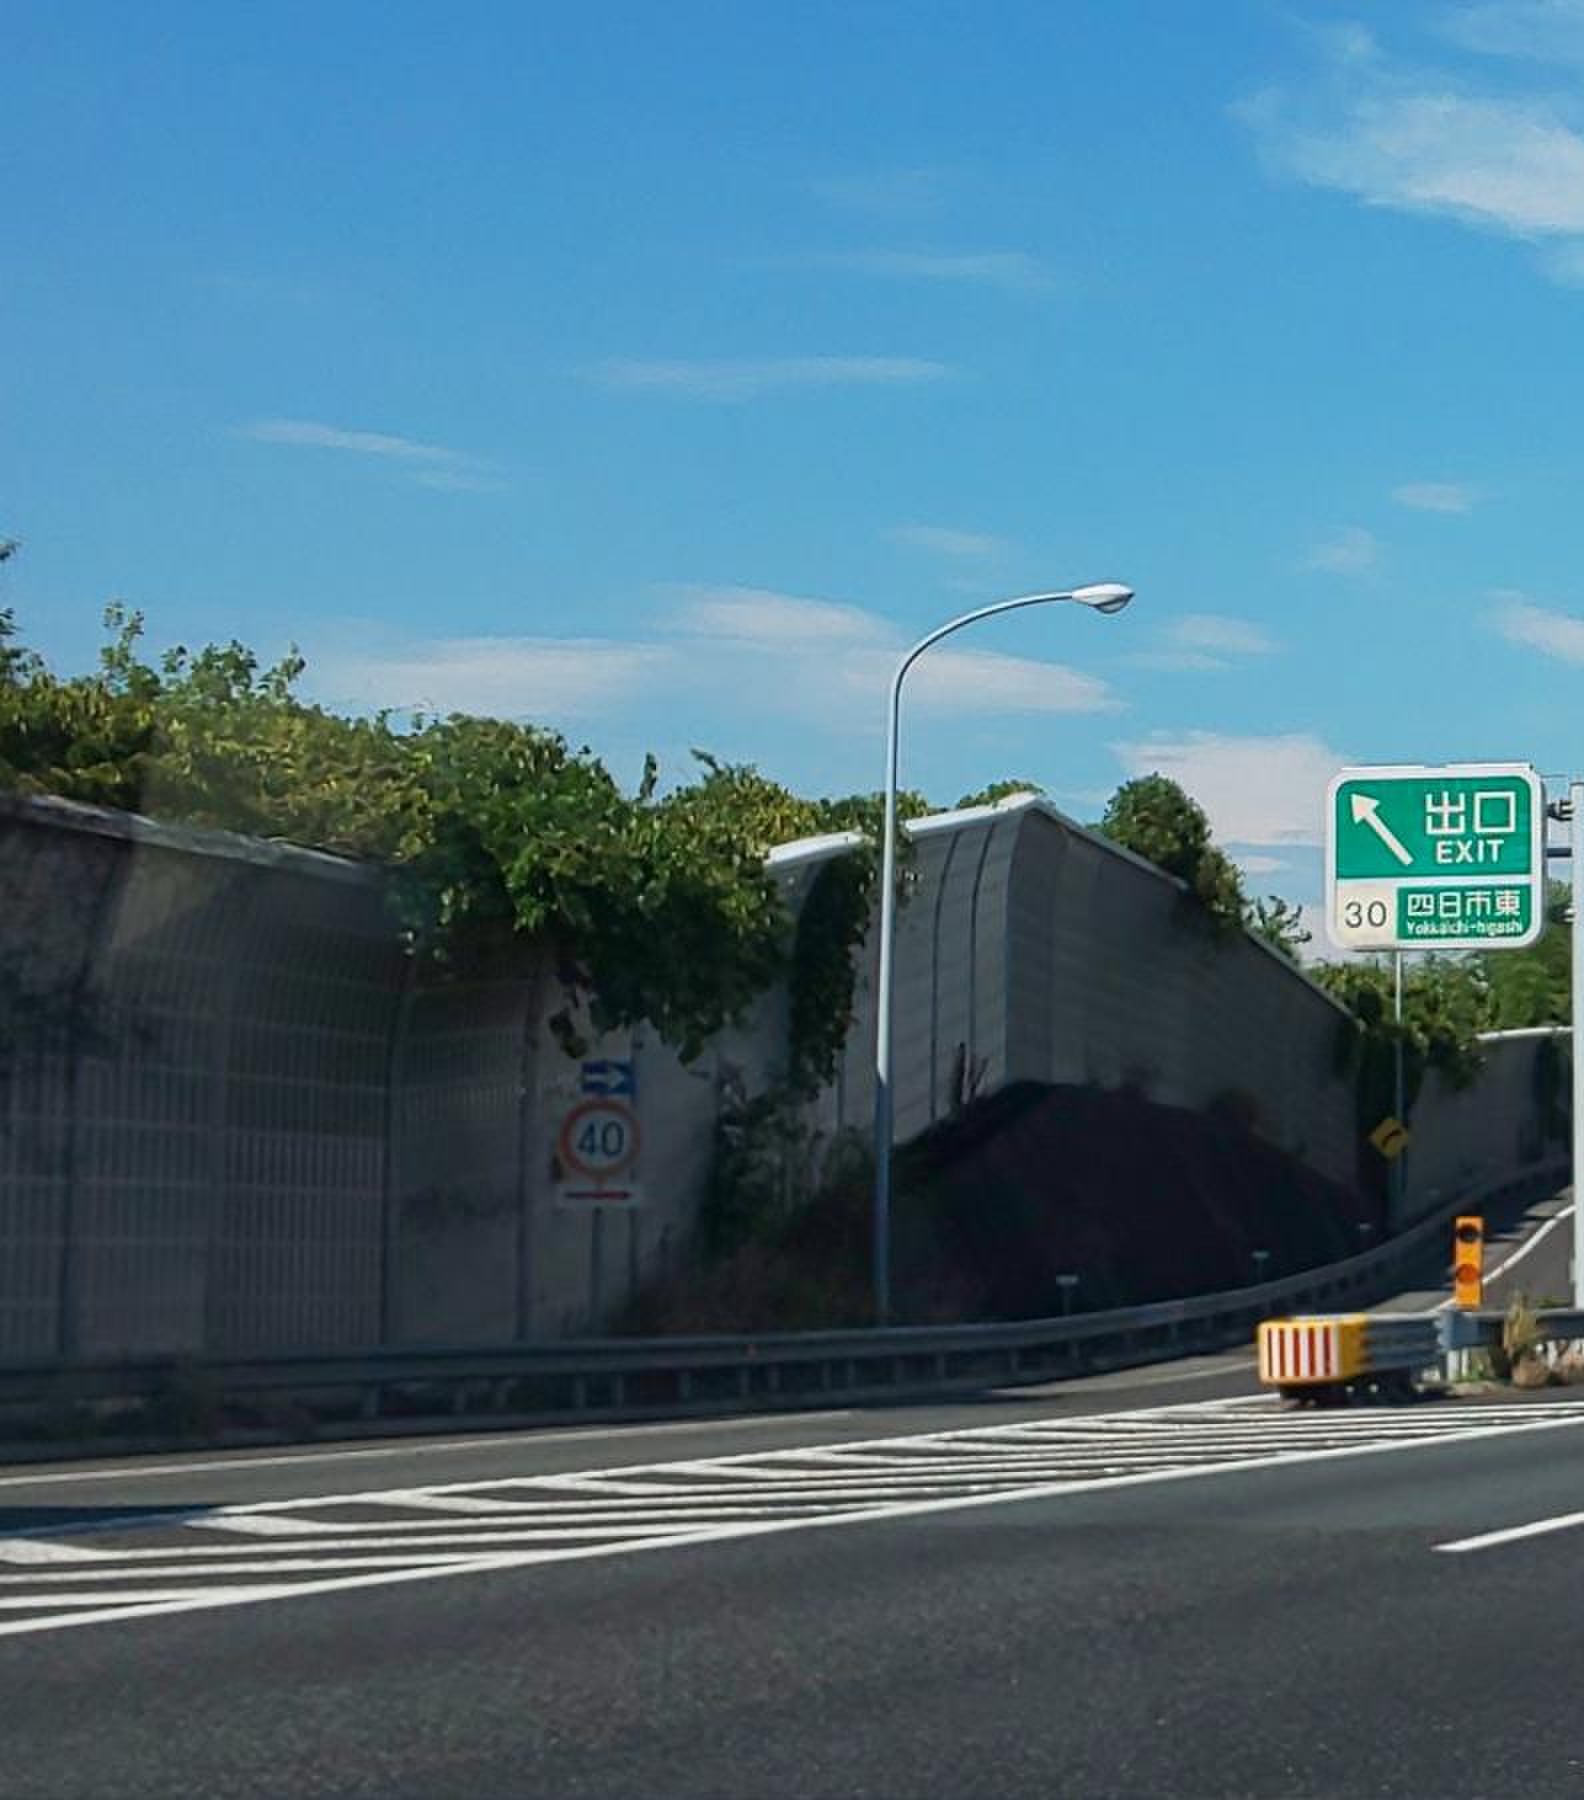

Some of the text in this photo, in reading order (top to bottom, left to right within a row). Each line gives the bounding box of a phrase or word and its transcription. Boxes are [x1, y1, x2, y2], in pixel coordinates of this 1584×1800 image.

[1425, 791, 1516, 835] 出口
[1436, 839, 1505, 863] EXIT
[1345, 901, 1387, 928] 30
[1407, 890, 1521, 919] 四日市東
[578, 1120, 625, 1157] 40
